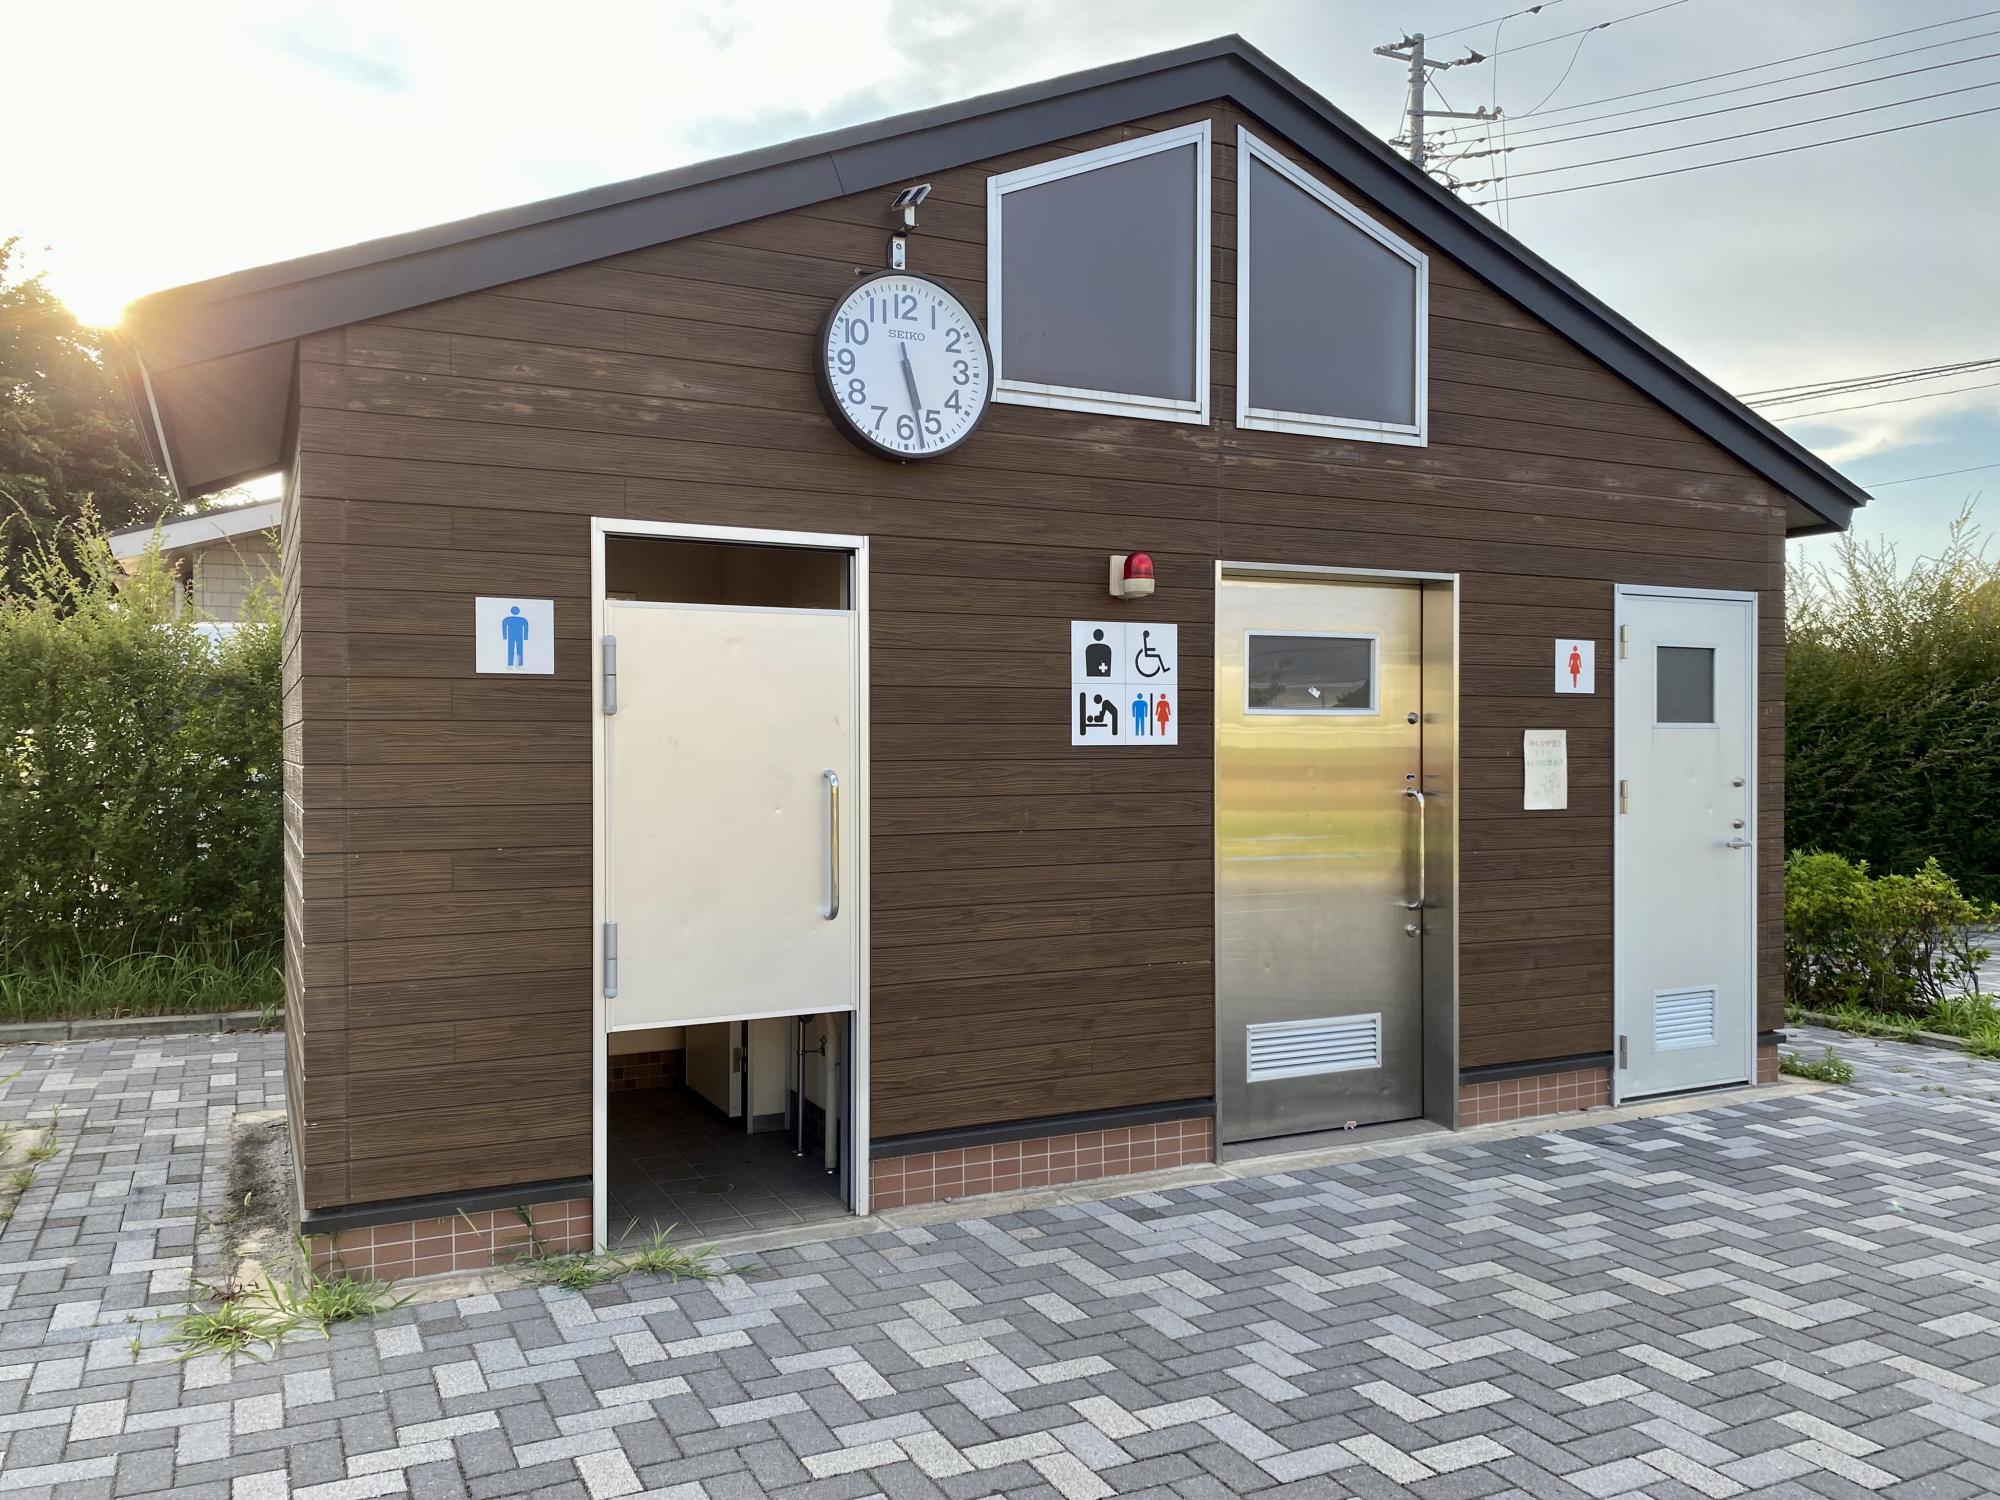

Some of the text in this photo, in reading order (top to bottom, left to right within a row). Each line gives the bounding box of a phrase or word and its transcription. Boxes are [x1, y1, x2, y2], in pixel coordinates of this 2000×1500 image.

[869, 297, 887, 324] 11
[894, 293, 918, 322] 12
[931, 305, 936, 330] 1
[844, 317, 869, 346] 10
[888, 329, 926, 342] SEIKO
[945, 327, 962, 354] 2
[837, 348, 856, 375] 9
[952, 359, 970, 386] 3
[847, 378, 867, 405] 8
[944, 389, 963, 414] 4
[870, 405, 889, 431] 7
[896, 414, 914, 441] 6
[924, 409, 942, 435] 5
